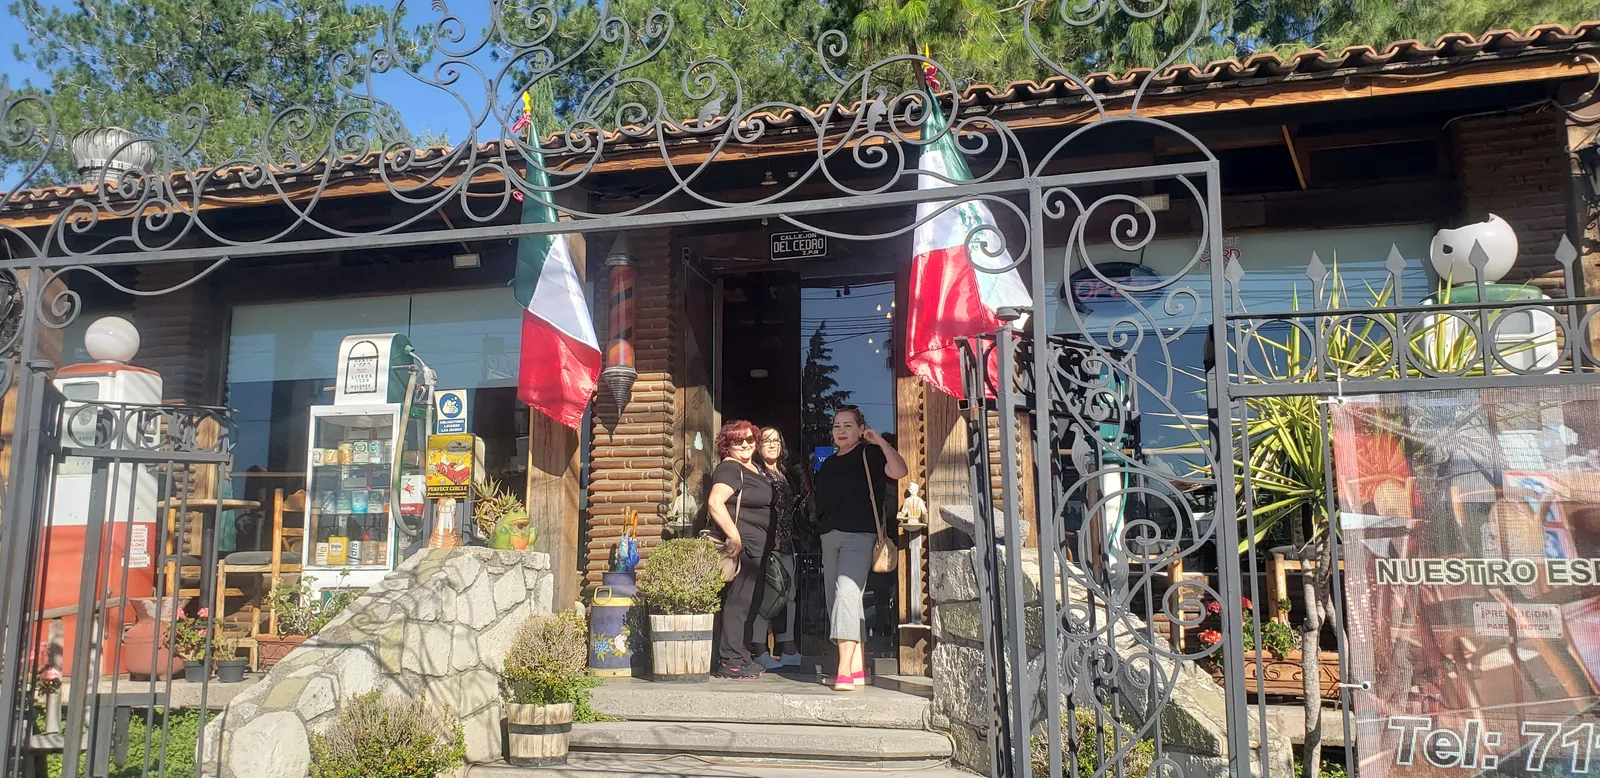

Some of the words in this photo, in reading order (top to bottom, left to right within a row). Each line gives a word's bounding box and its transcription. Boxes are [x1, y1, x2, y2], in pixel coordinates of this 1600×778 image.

[773, 241, 792, 253] DEL
[793, 238, 824, 251] CEDRO
[780, 233, 817, 241] CALLEJON
[1375, 558, 1538, 586] NUESTRO
[1388, 716, 1502, 770] Tel:
[1521, 721, 1600, 774] 71
